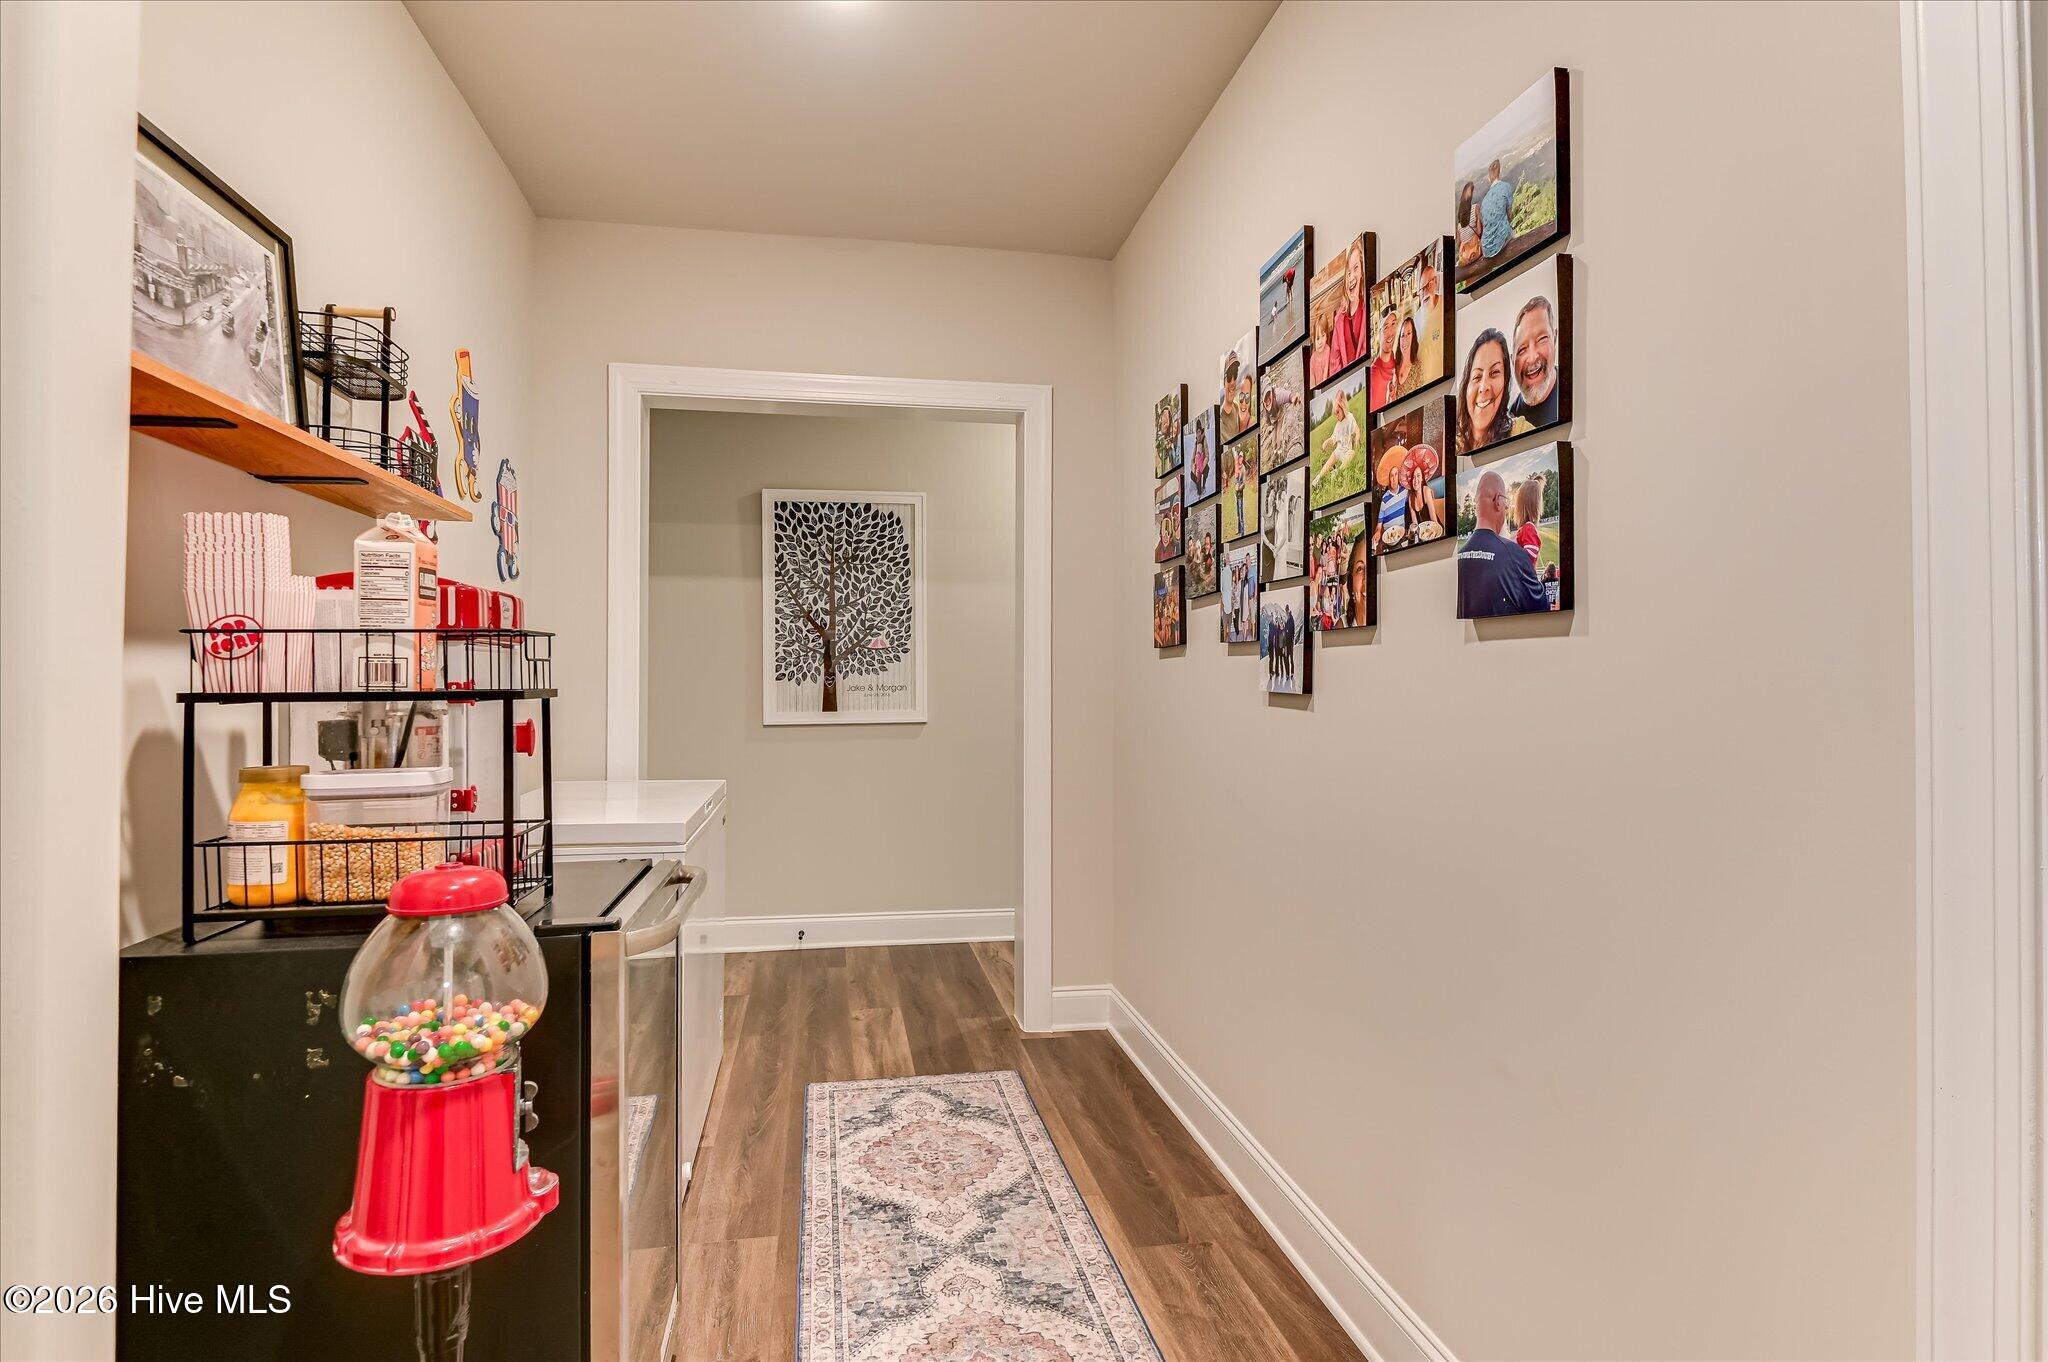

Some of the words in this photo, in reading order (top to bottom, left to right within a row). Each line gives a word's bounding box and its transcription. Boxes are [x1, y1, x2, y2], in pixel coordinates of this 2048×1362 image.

[209, 619, 247, 641] POP
[210, 632, 263, 655] CORN
[846, 684, 866, 692] Jake
[867, 683, 874, 692] &
[876, 683, 908, 693] Morgan
